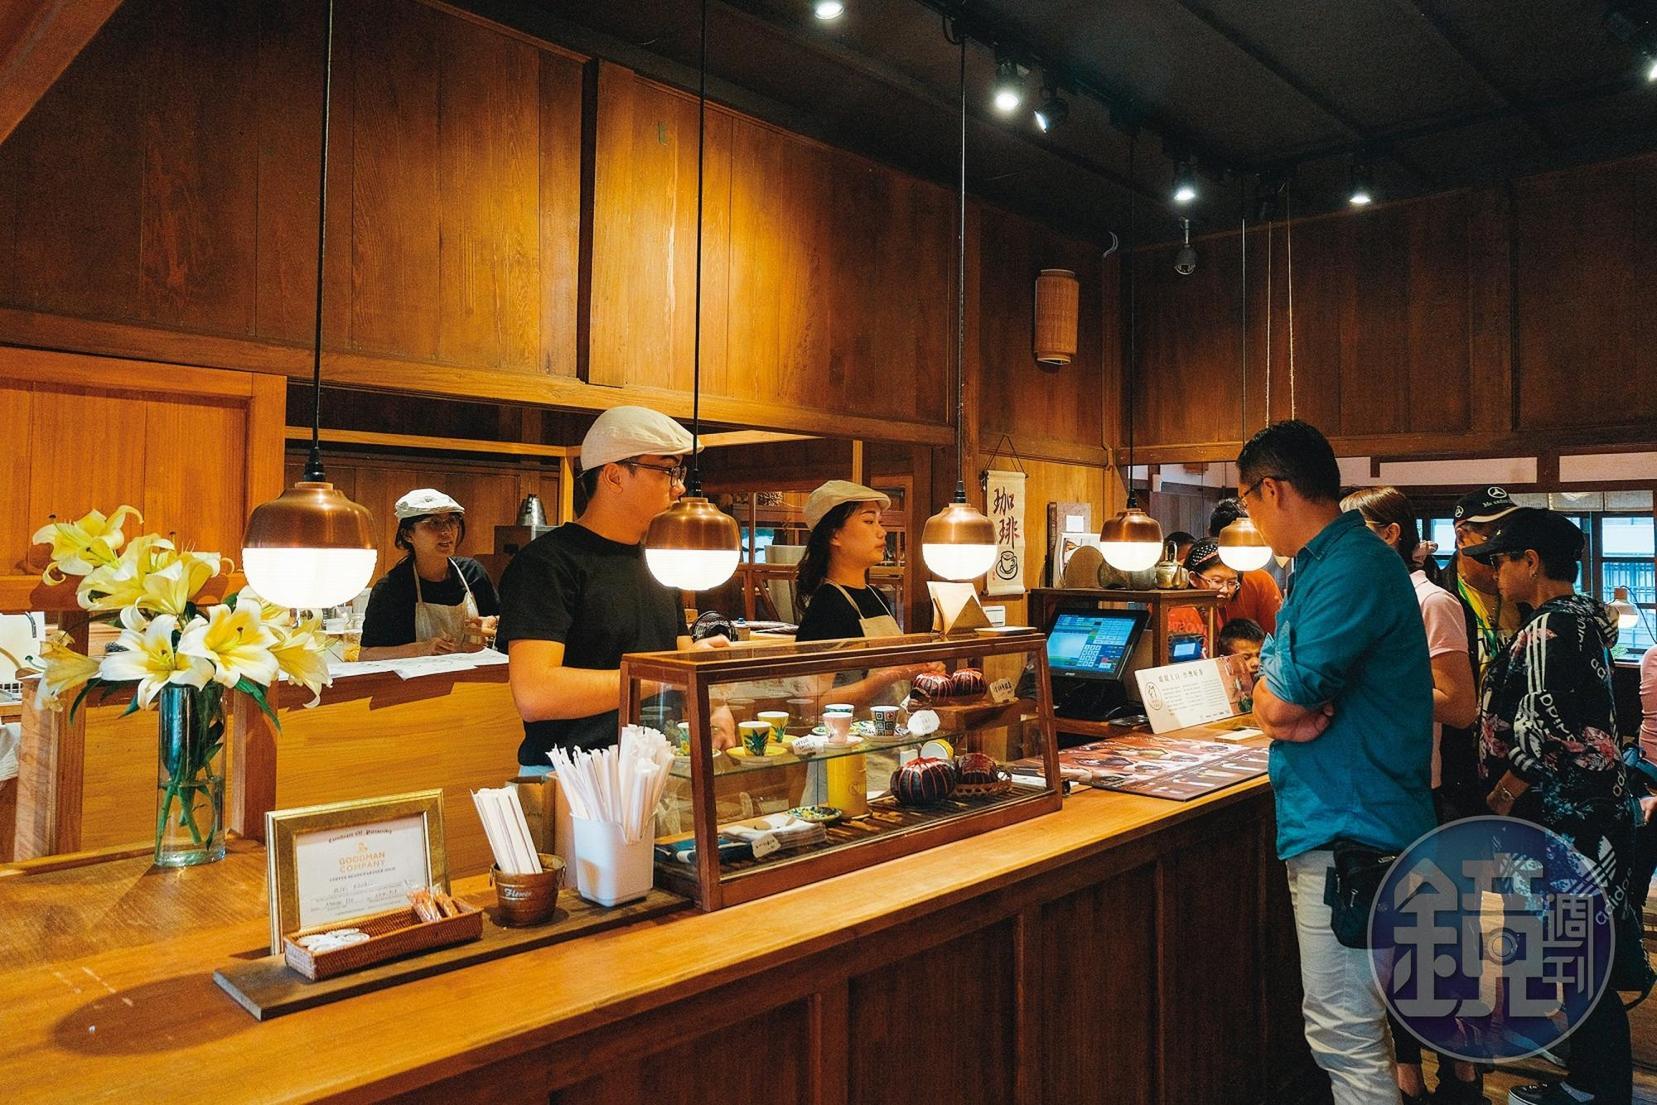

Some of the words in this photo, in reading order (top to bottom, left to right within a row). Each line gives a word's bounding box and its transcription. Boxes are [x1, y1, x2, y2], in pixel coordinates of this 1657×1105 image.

[992, 486, 1020, 549] 珈琲
[338, 851, 385, 865] GOODMAN
[339, 859, 385, 874] COMPANY
